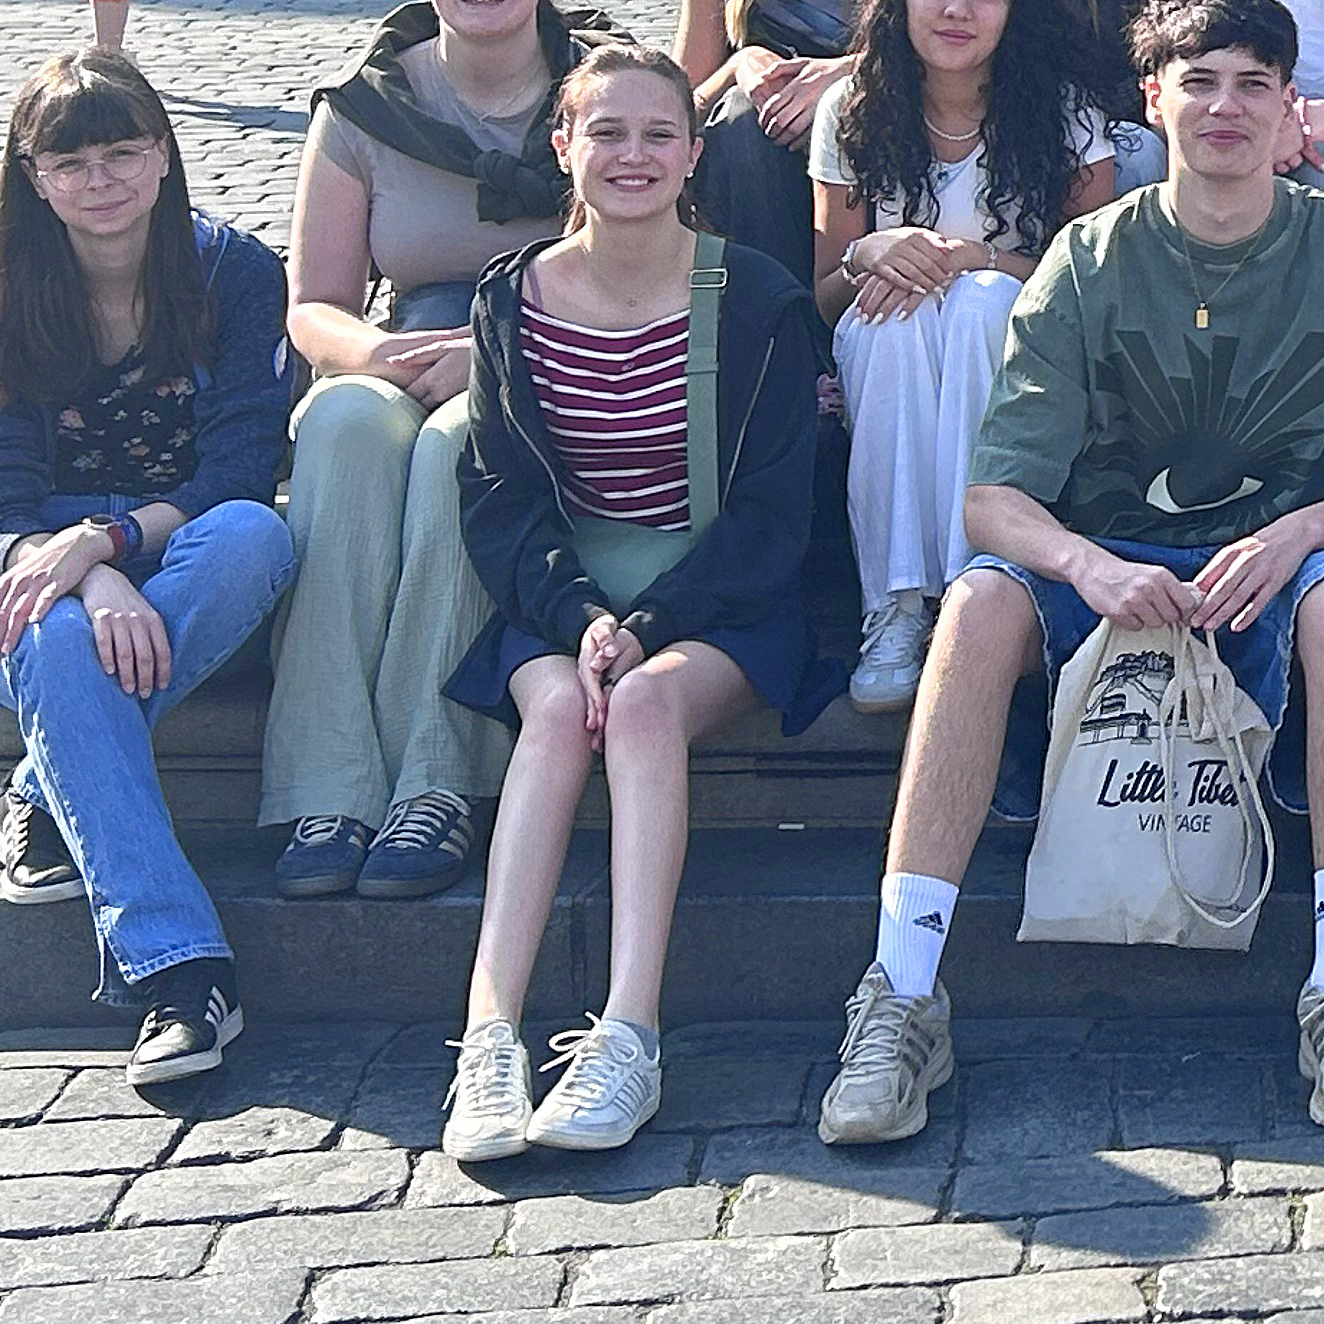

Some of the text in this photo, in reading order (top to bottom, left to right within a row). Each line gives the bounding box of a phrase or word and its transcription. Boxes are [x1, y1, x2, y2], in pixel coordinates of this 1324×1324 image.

[1097, 759, 1246, 807] Littl Tibe
[1138, 813, 1212, 833] VINAGE
